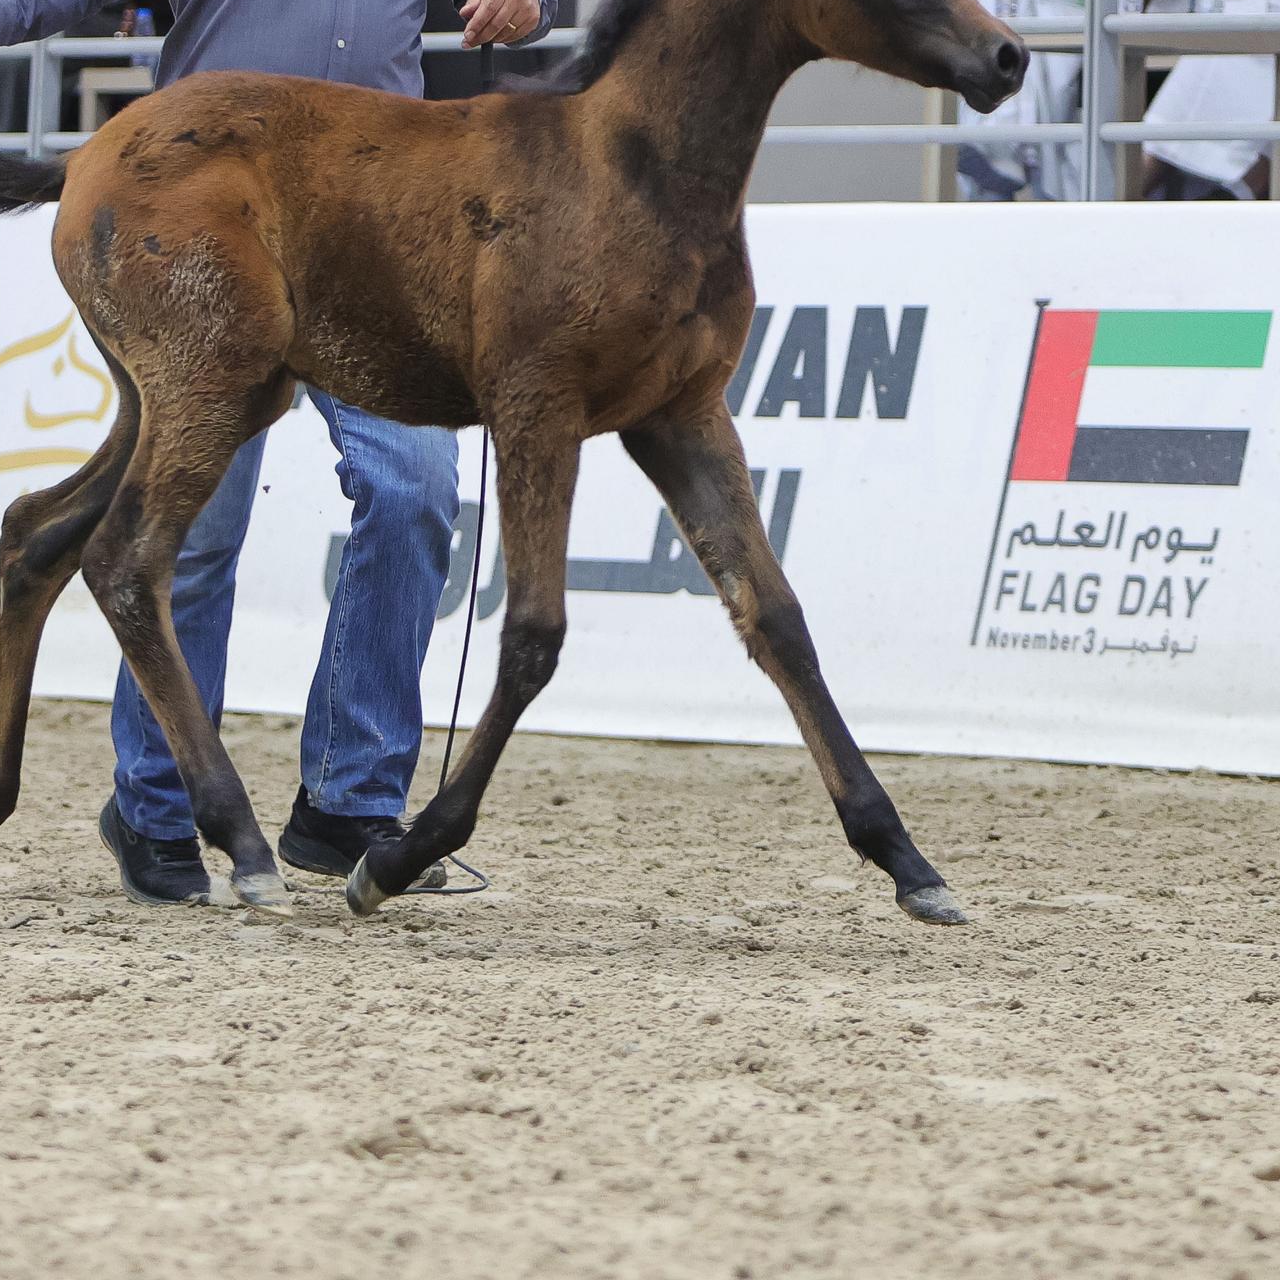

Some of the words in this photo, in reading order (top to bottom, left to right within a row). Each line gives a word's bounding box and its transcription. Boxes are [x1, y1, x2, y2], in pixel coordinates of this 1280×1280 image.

[1005, 509, 1127, 559] العلم
[1128, 525, 1220, 565] يوم
[994, 569, 1102, 614] FLAG
[1119, 574, 1209, 619] DAY
[986, 626, 1080, 651] November
[1082, 626, 1096, 654] 3
[1098, 628, 1200, 660] نوفمبر
